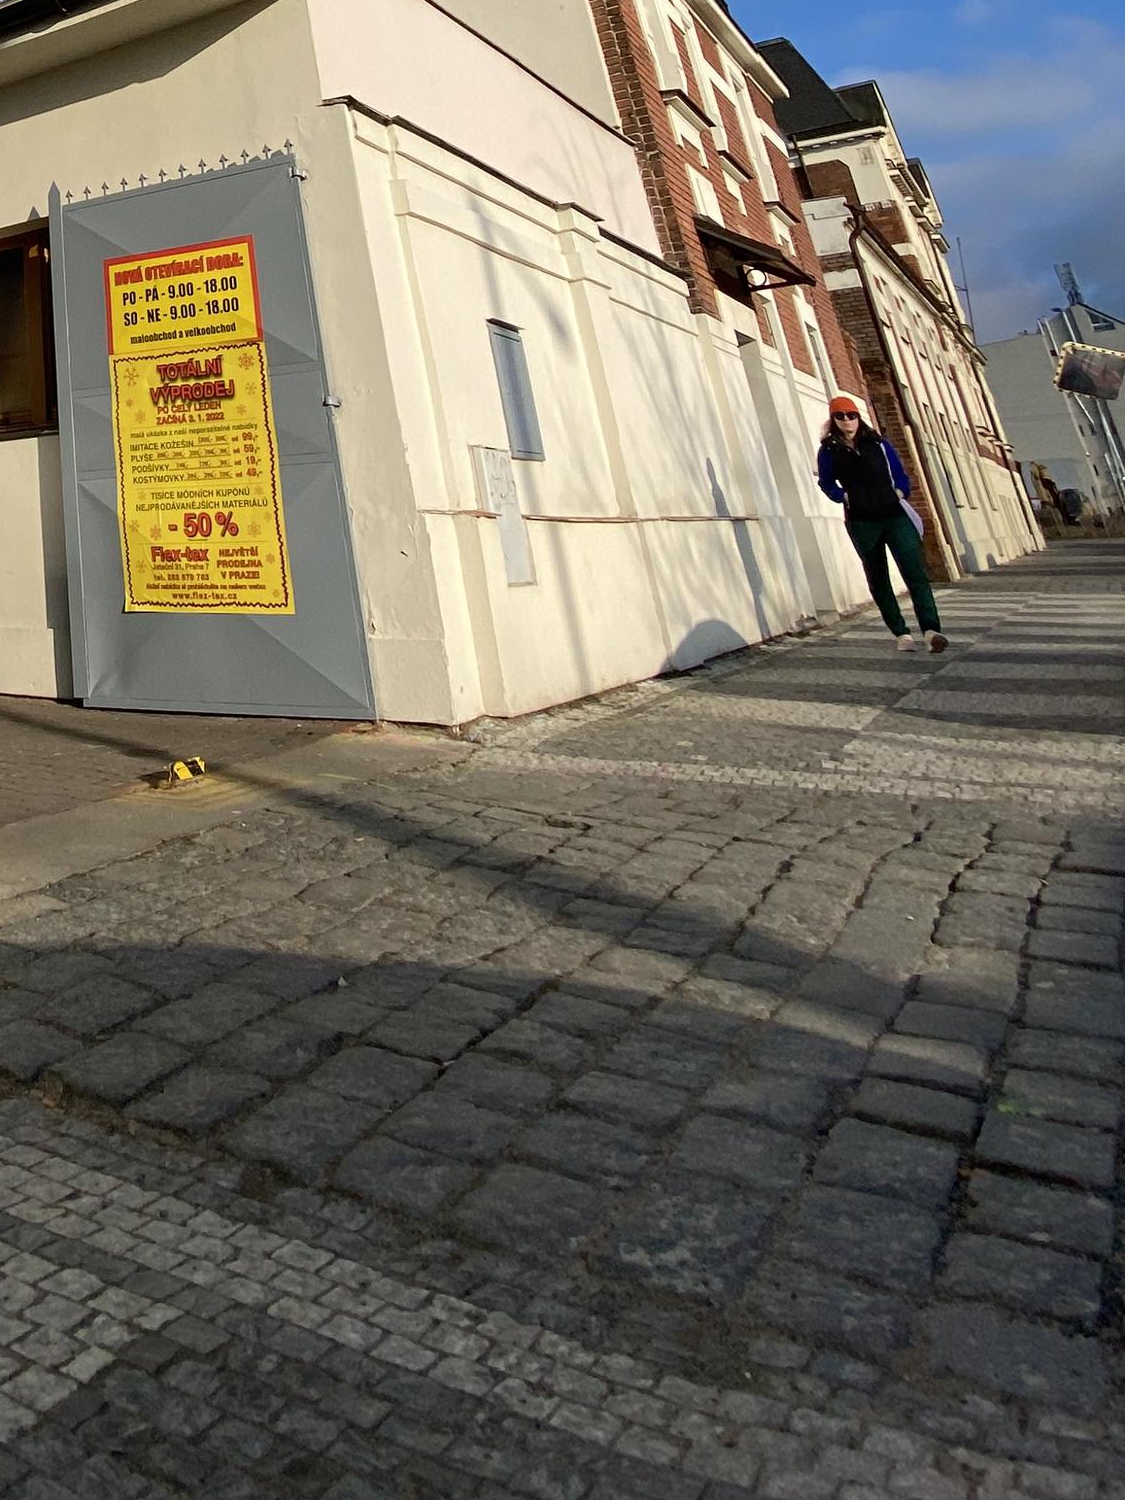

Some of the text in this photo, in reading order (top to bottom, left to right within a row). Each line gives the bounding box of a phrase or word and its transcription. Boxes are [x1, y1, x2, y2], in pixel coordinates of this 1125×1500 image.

[122, 291, 136, 306] PO
[145, 285, 159, 302] PÁ
[168, 282, 194, 299] 9.00
[203, 275, 238, 293] 18.00
[124, 312, 137, 326] SO
[147, 308, 161, 323] NE
[170, 303, 196, 320] 9.00
[205, 297, 239, 315] 18.00
[130, 322, 236, 344] maloobchod a velkoobchod
[156, 355, 223, 381] TOTÁLNÍ
[150, 379, 235, 405] VÝPRODEJ
[157, 405, 169, 414] PO
[130, 442, 159, 451] IMITACE
[130, 452, 154, 463] PLYŠE
[151, 490, 175, 500] TISÍCE
[176, 488, 214, 499] MÓDNÍCH
[222, 496, 269, 509] MATERIÁLŮ
[183, 512, 212, 538] 50
[214, 511, 239, 537] %
[150, 546, 210, 562] Flex-tex
